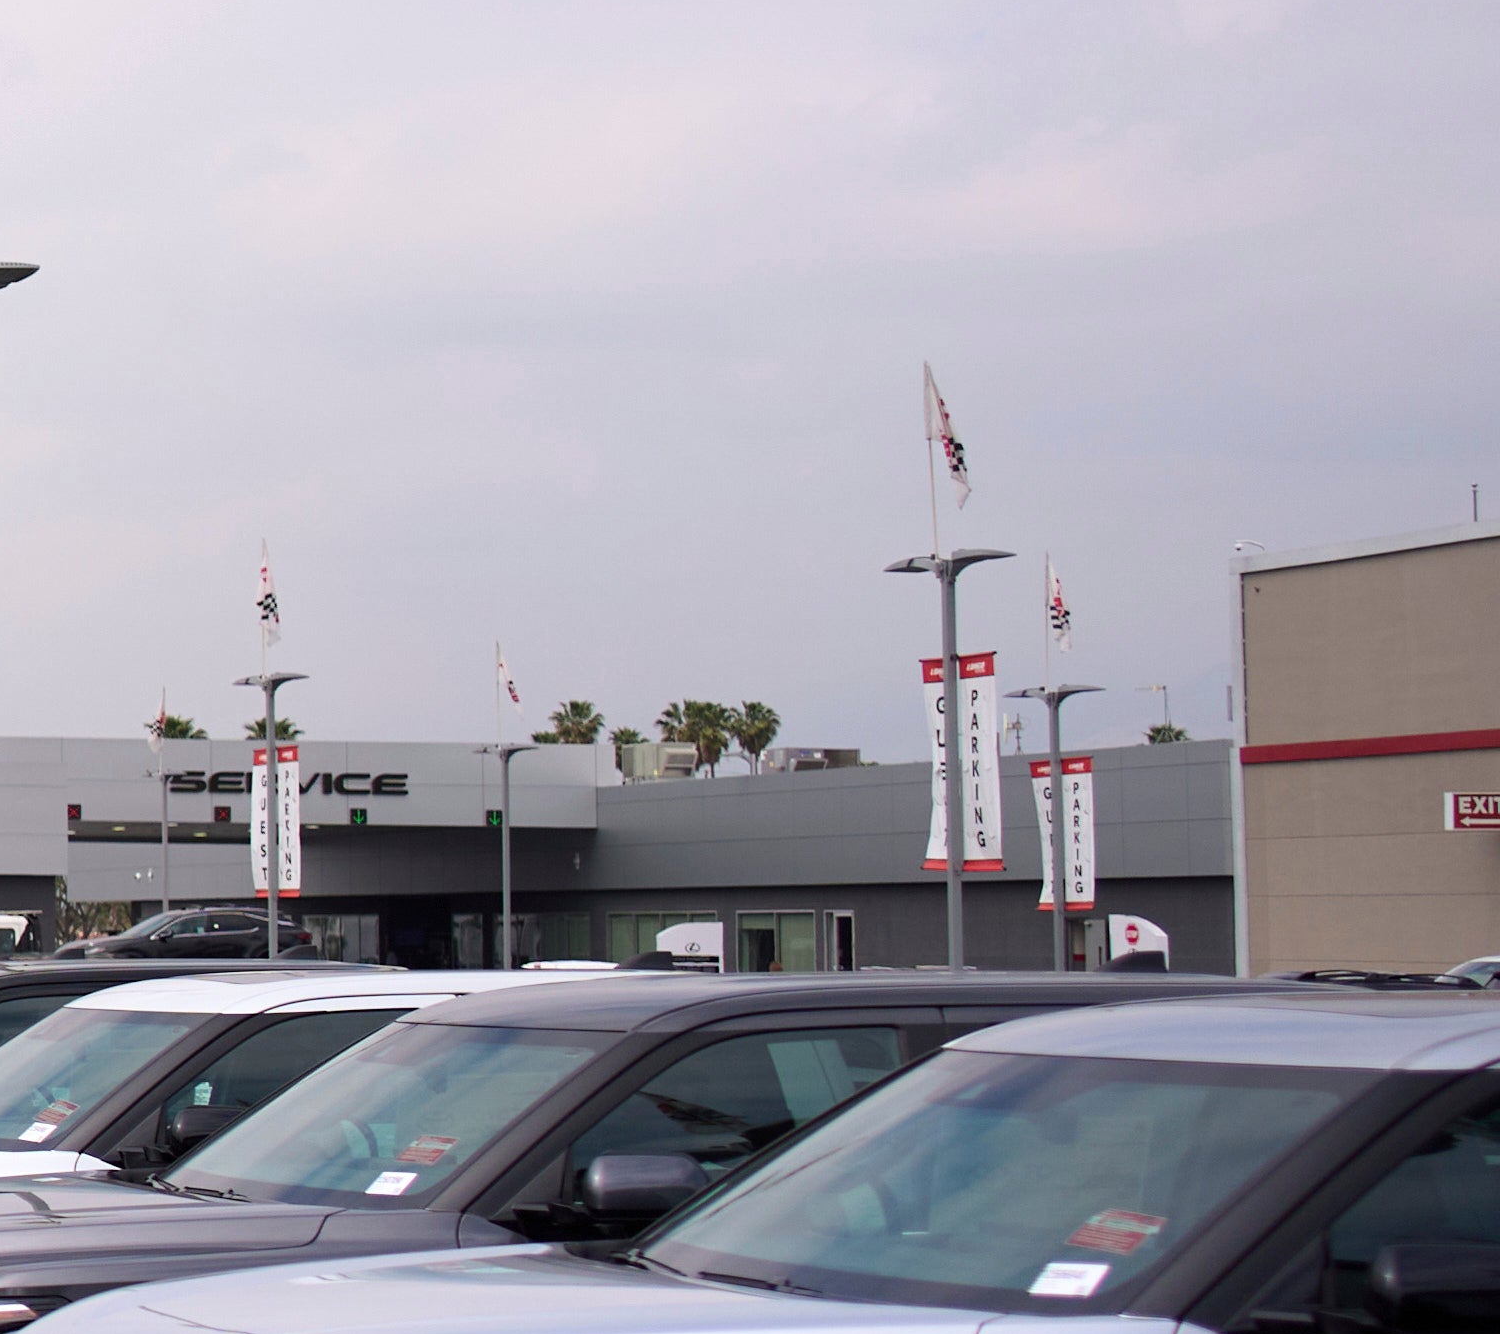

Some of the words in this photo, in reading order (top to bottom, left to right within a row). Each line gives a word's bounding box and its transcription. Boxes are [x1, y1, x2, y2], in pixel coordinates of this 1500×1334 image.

[169, 771, 408, 795] SEVICE
[971, 690, 986, 848] PARKING
[1073, 782, 1083, 894] PARKING
